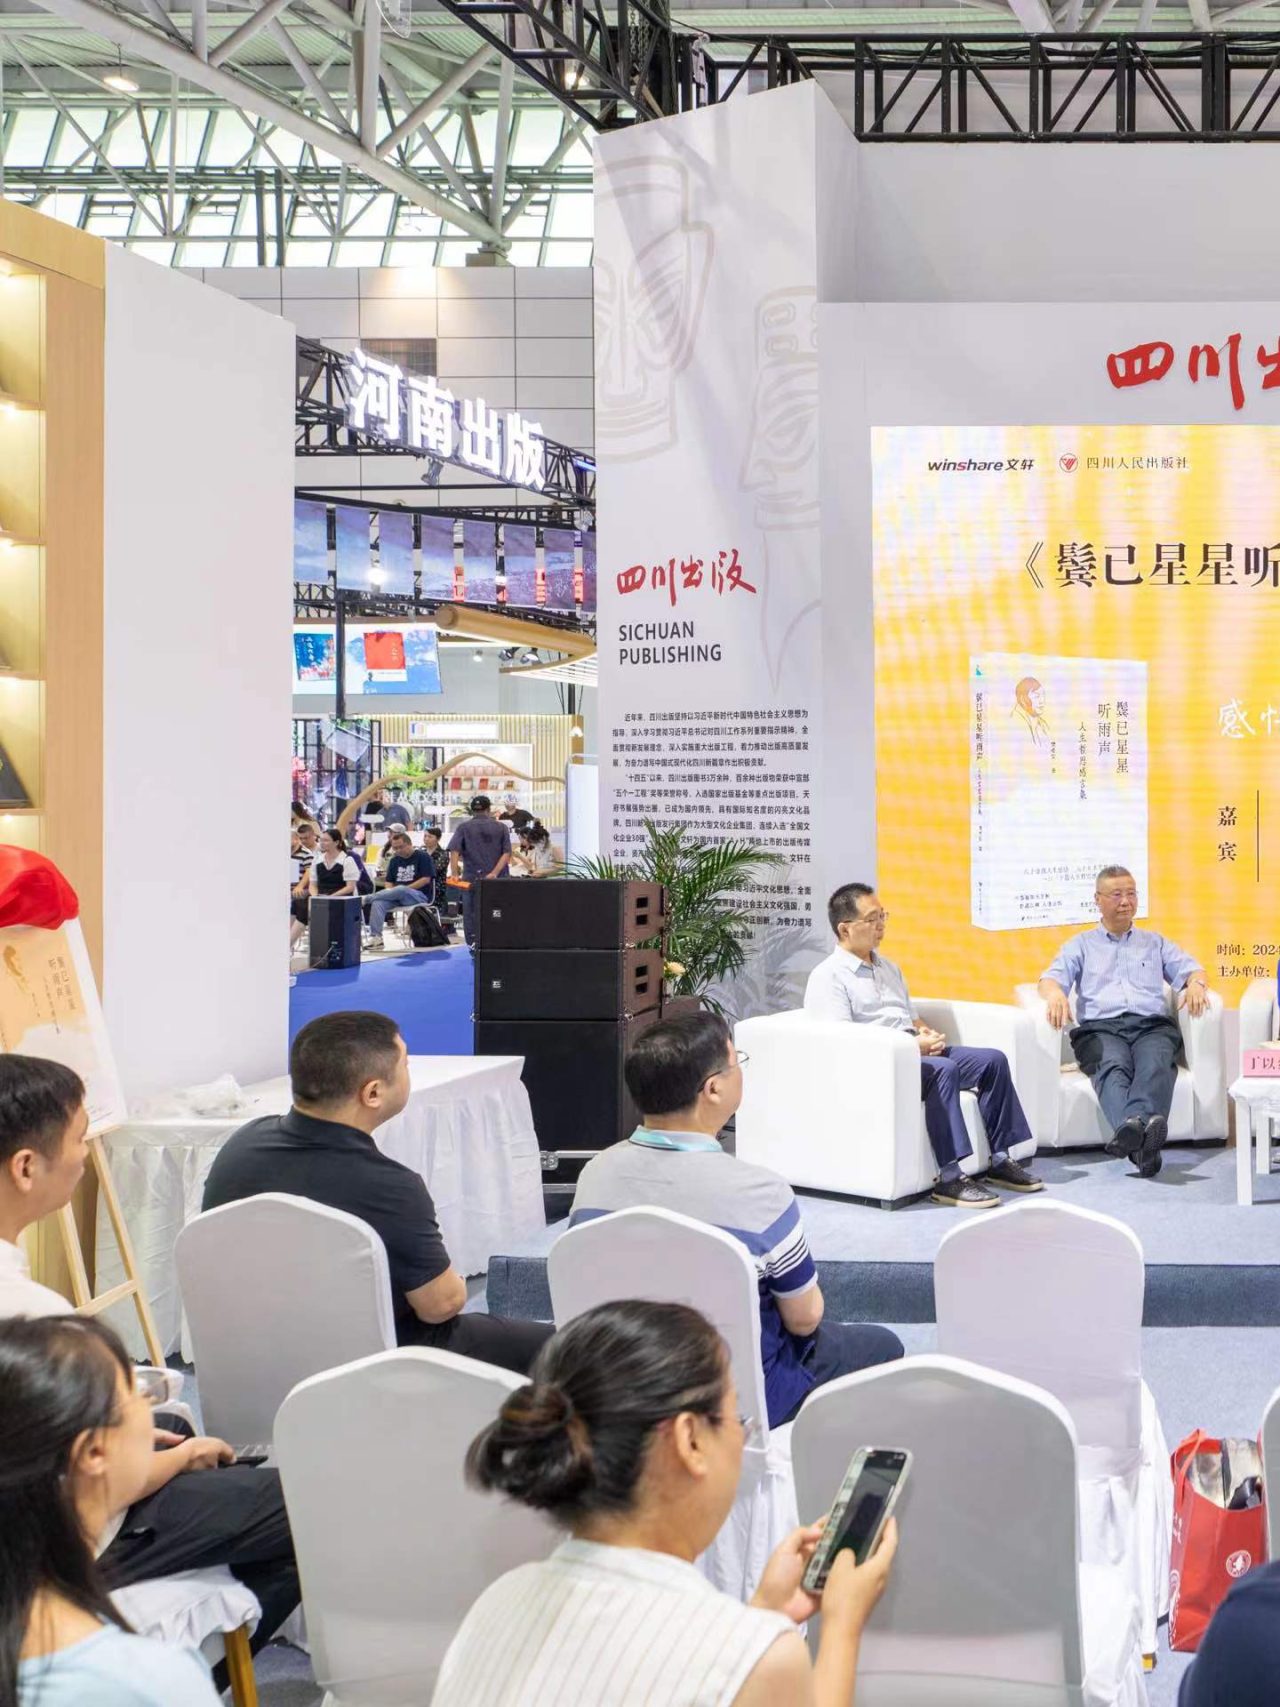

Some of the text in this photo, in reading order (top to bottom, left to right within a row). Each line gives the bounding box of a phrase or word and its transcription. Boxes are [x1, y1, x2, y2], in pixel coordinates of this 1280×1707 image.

[347, 346, 546, 491] 河南出版
[1087, 456, 1189, 470] 四川人民出版社
[617, 549, 757, 607] 四川出版
[619, 621, 695, 641] SICHUAN
[619, 644, 722, 665] PUBLISHING
[1098, 702, 1111, 757] 听雨声
[1217, 965, 1271, 978] 主办单位：
